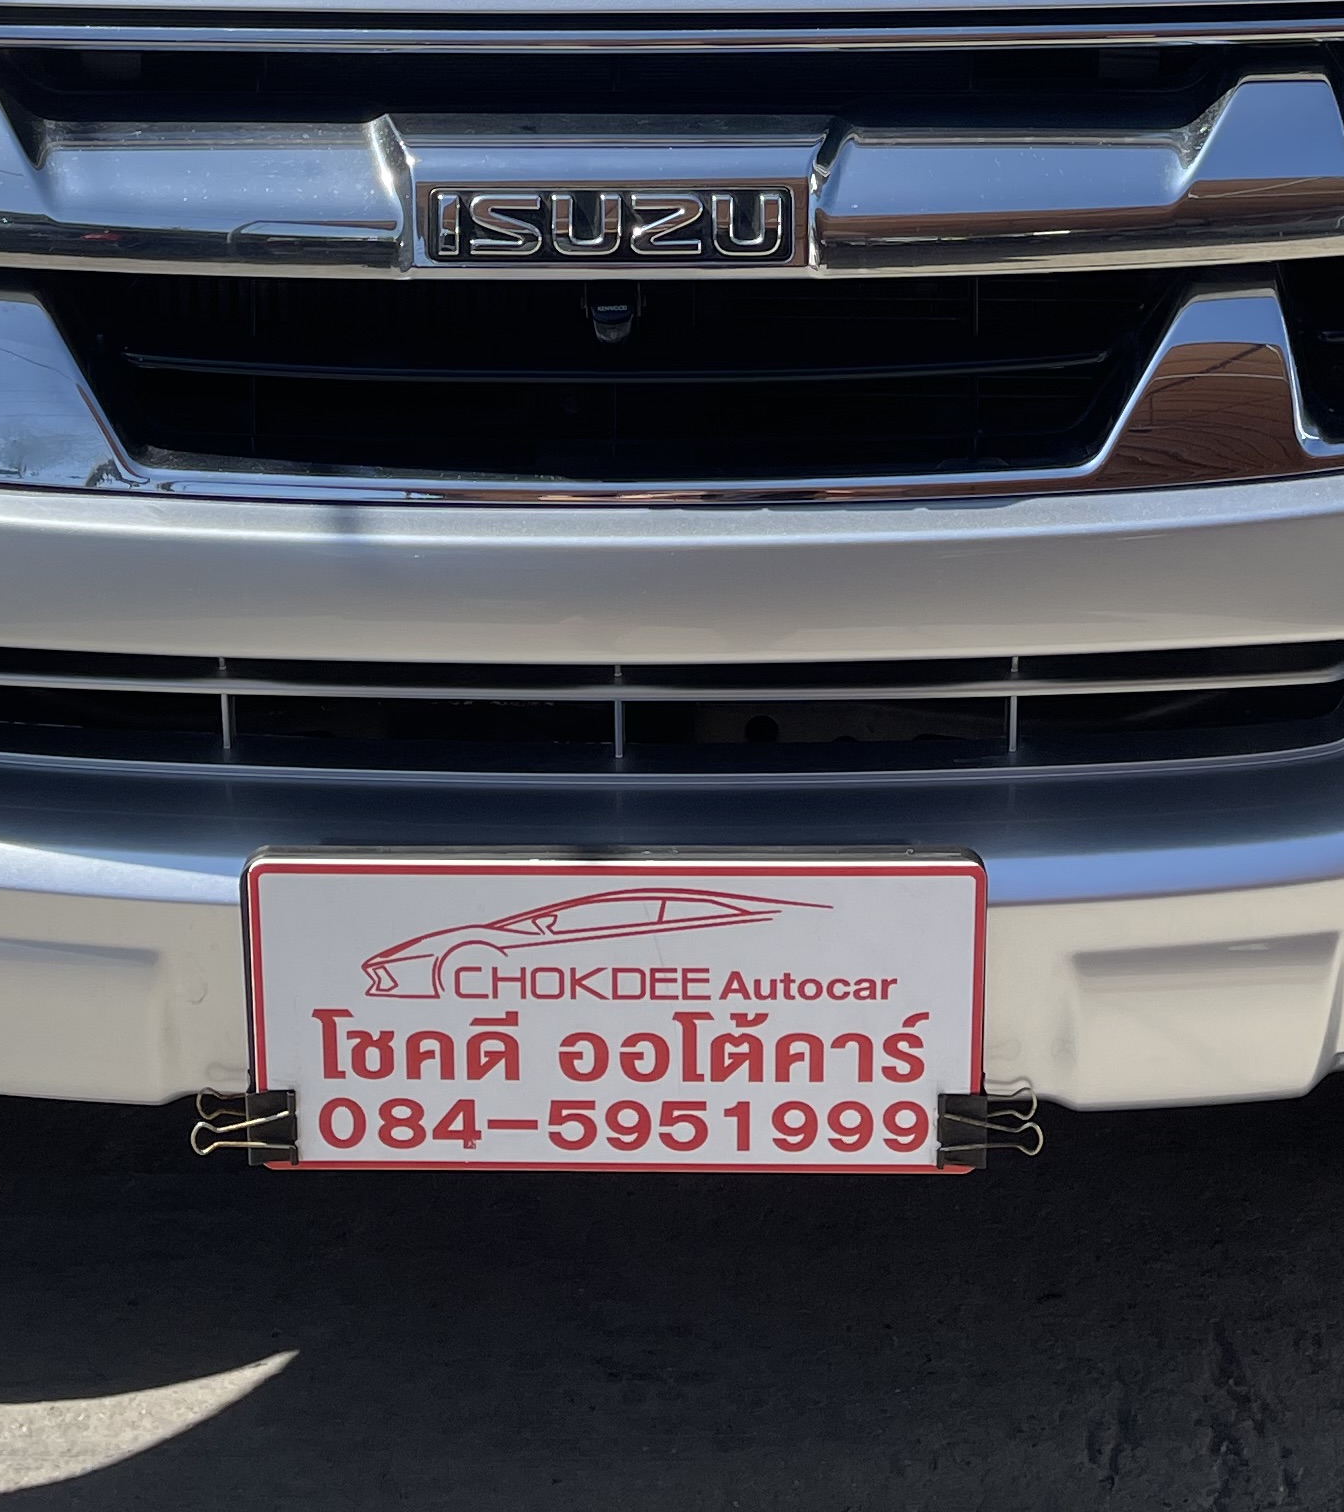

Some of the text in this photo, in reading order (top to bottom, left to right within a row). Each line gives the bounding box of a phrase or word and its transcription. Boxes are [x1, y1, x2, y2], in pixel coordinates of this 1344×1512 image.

[437, 193, 783, 257] ISUZU
[454, 966, 898, 1001] CHOKDEE Autocar
[312, 1008, 930, 1083] โชคดี ออโต้คาร์
[319, 1096, 929, 1153] 084-5951999
